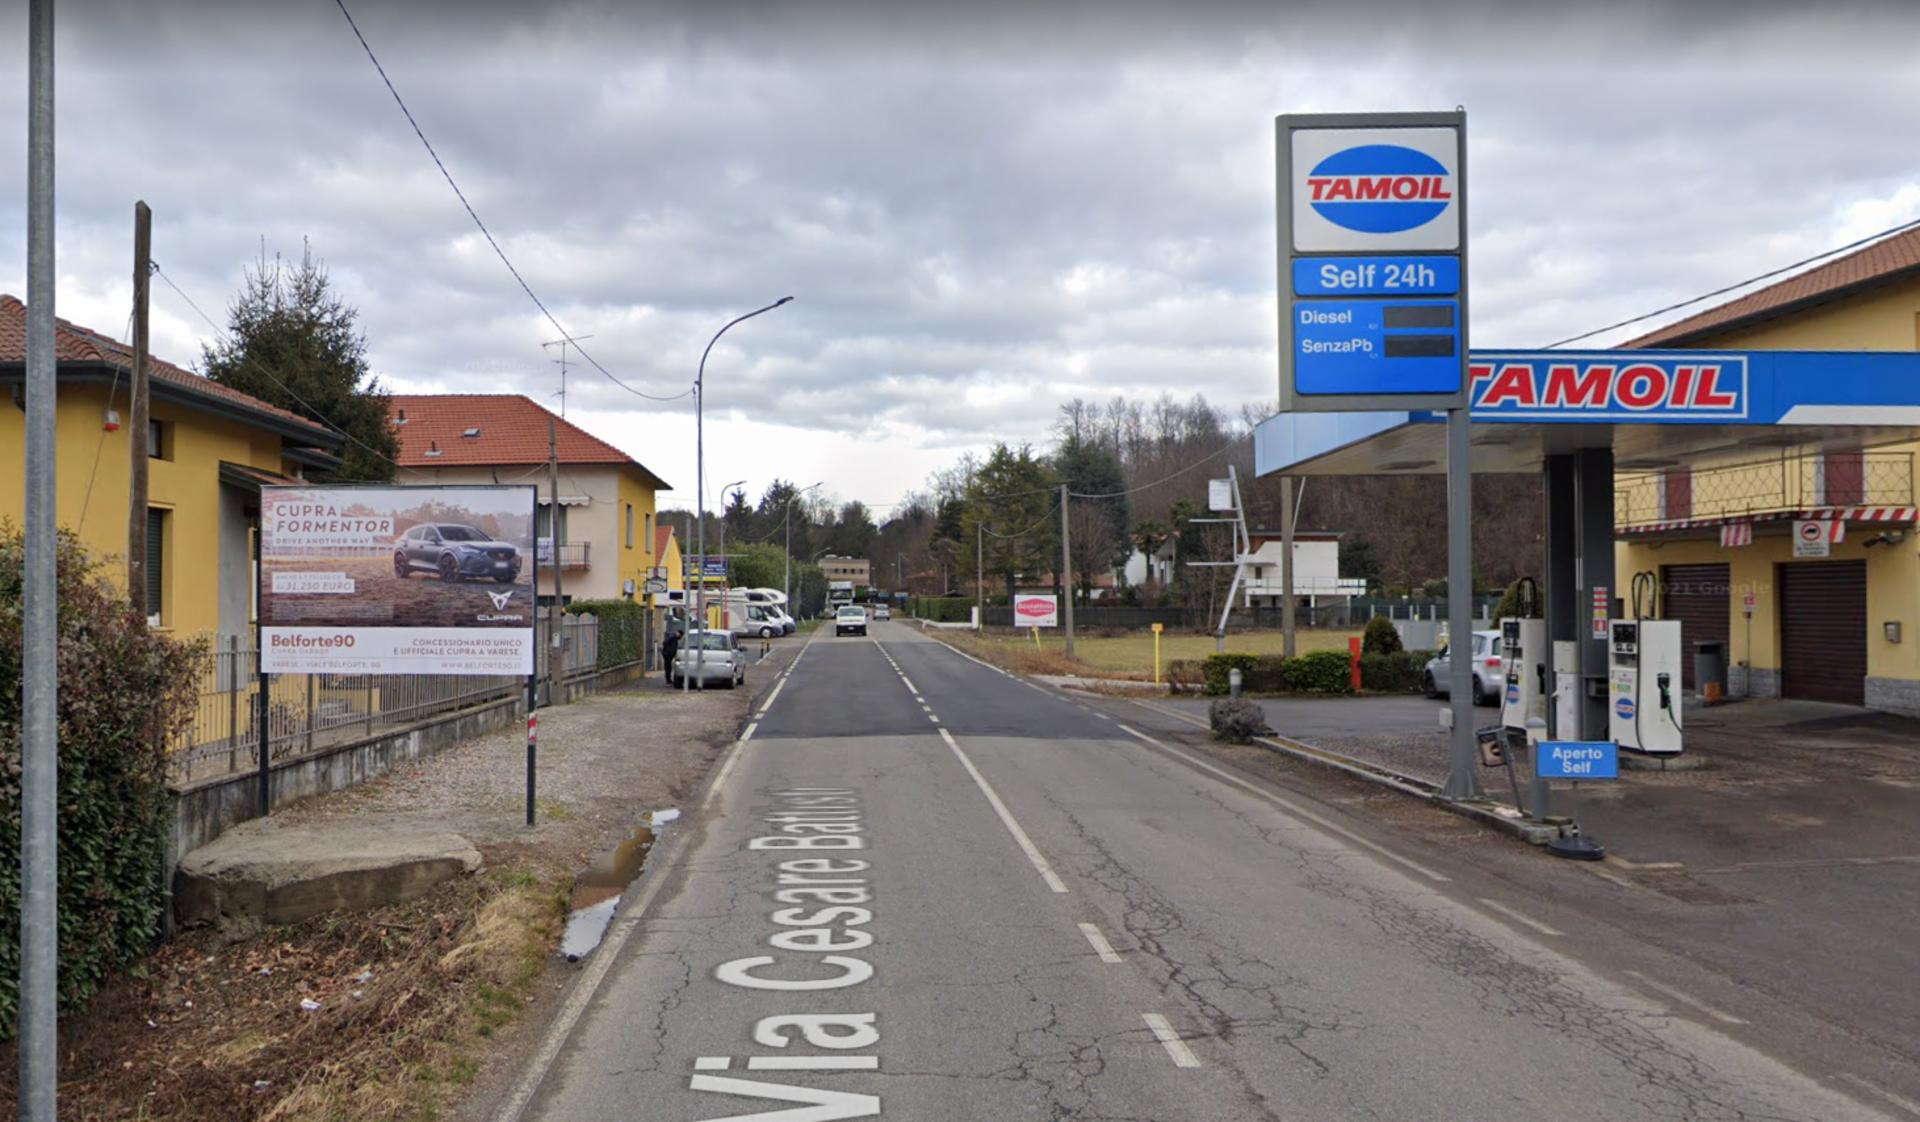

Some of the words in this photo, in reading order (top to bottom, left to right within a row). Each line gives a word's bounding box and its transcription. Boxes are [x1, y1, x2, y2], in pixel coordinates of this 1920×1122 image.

[1307, 176, 1452, 201] TAMOIL
[1320, 264, 1376, 289] Self
[1384, 264, 1435, 288] 24h
[1301, 310, 1352, 324] Diesel
[1302, 338, 1373, 354] SenzaPb
[276, 504, 337, 518] CUPRA
[276, 520, 390, 533] FORMENTOR
[271, 633, 356, 648] Belforte90
[400, 648, 445, 656] UFFICIALE
[446, 648, 477, 656] CUPRA
[478, 648, 485, 656] A
[1552, 747, 1603, 761] Aperto
[1562, 761, 1592, 774] Self
